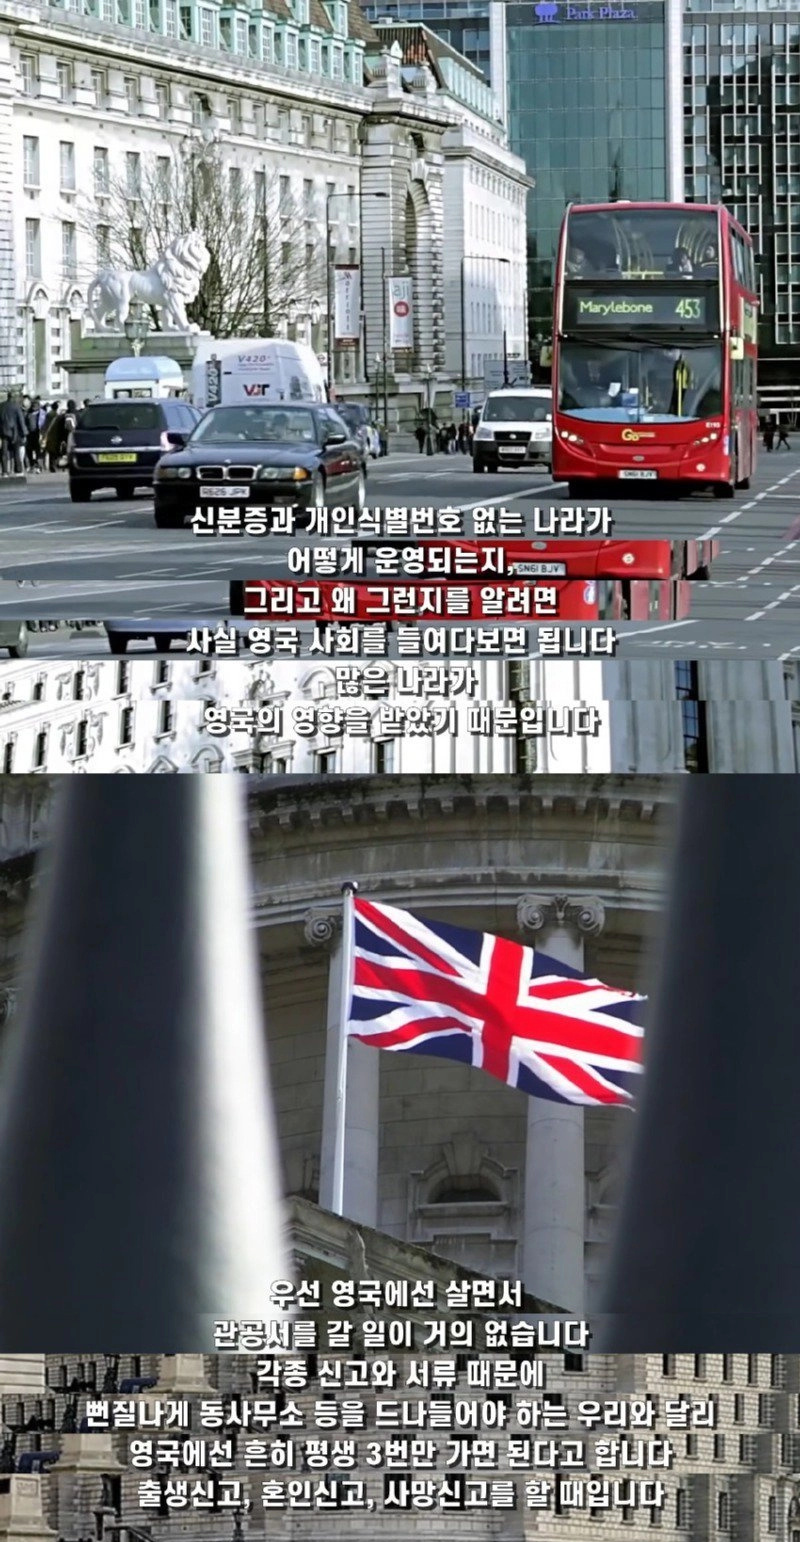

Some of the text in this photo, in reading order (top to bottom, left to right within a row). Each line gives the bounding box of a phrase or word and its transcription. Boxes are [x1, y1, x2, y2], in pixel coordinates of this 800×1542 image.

[566, 8, 594, 20] Park
[579, 298, 702, 319] Marylebone 453
[517, 564, 560, 574] SN61 BJV
